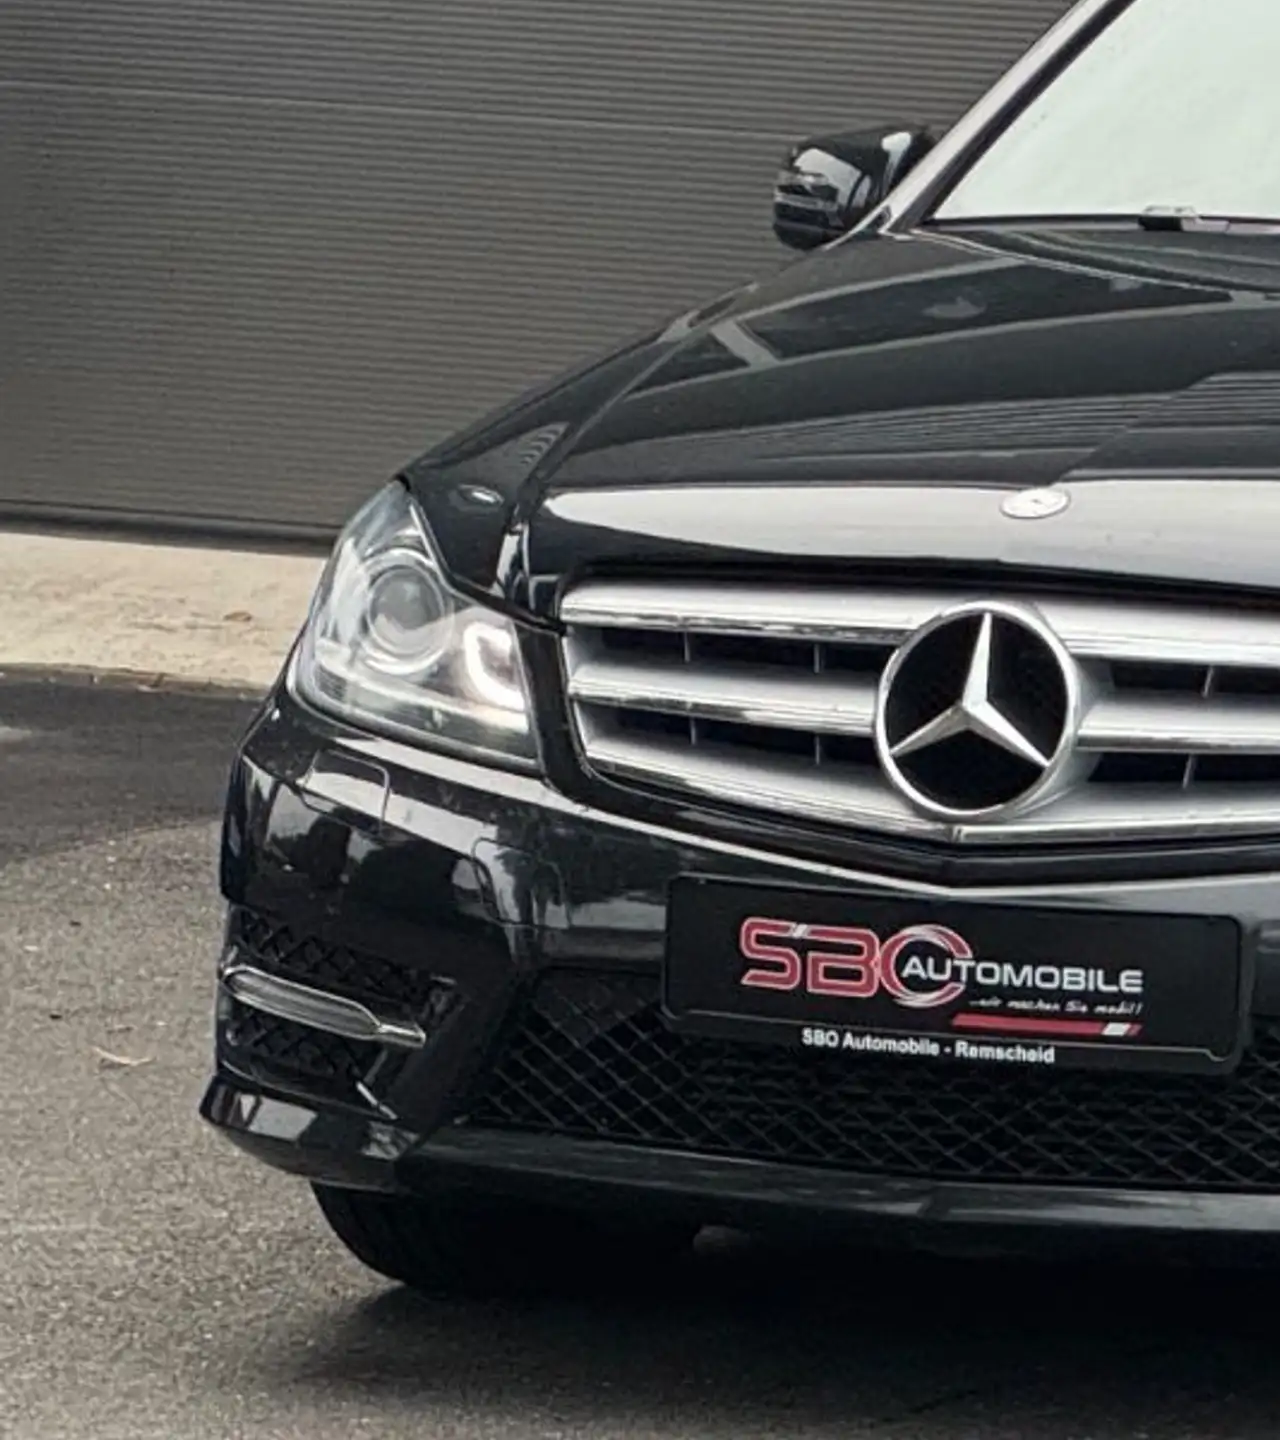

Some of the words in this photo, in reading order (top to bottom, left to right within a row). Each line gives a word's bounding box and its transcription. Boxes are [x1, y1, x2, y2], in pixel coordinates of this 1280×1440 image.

[902, 956, 1144, 992] AUTOMOBILE
[802, 1028, 840, 1048] SBO
[842, 1033, 940, 1057] Automobile
